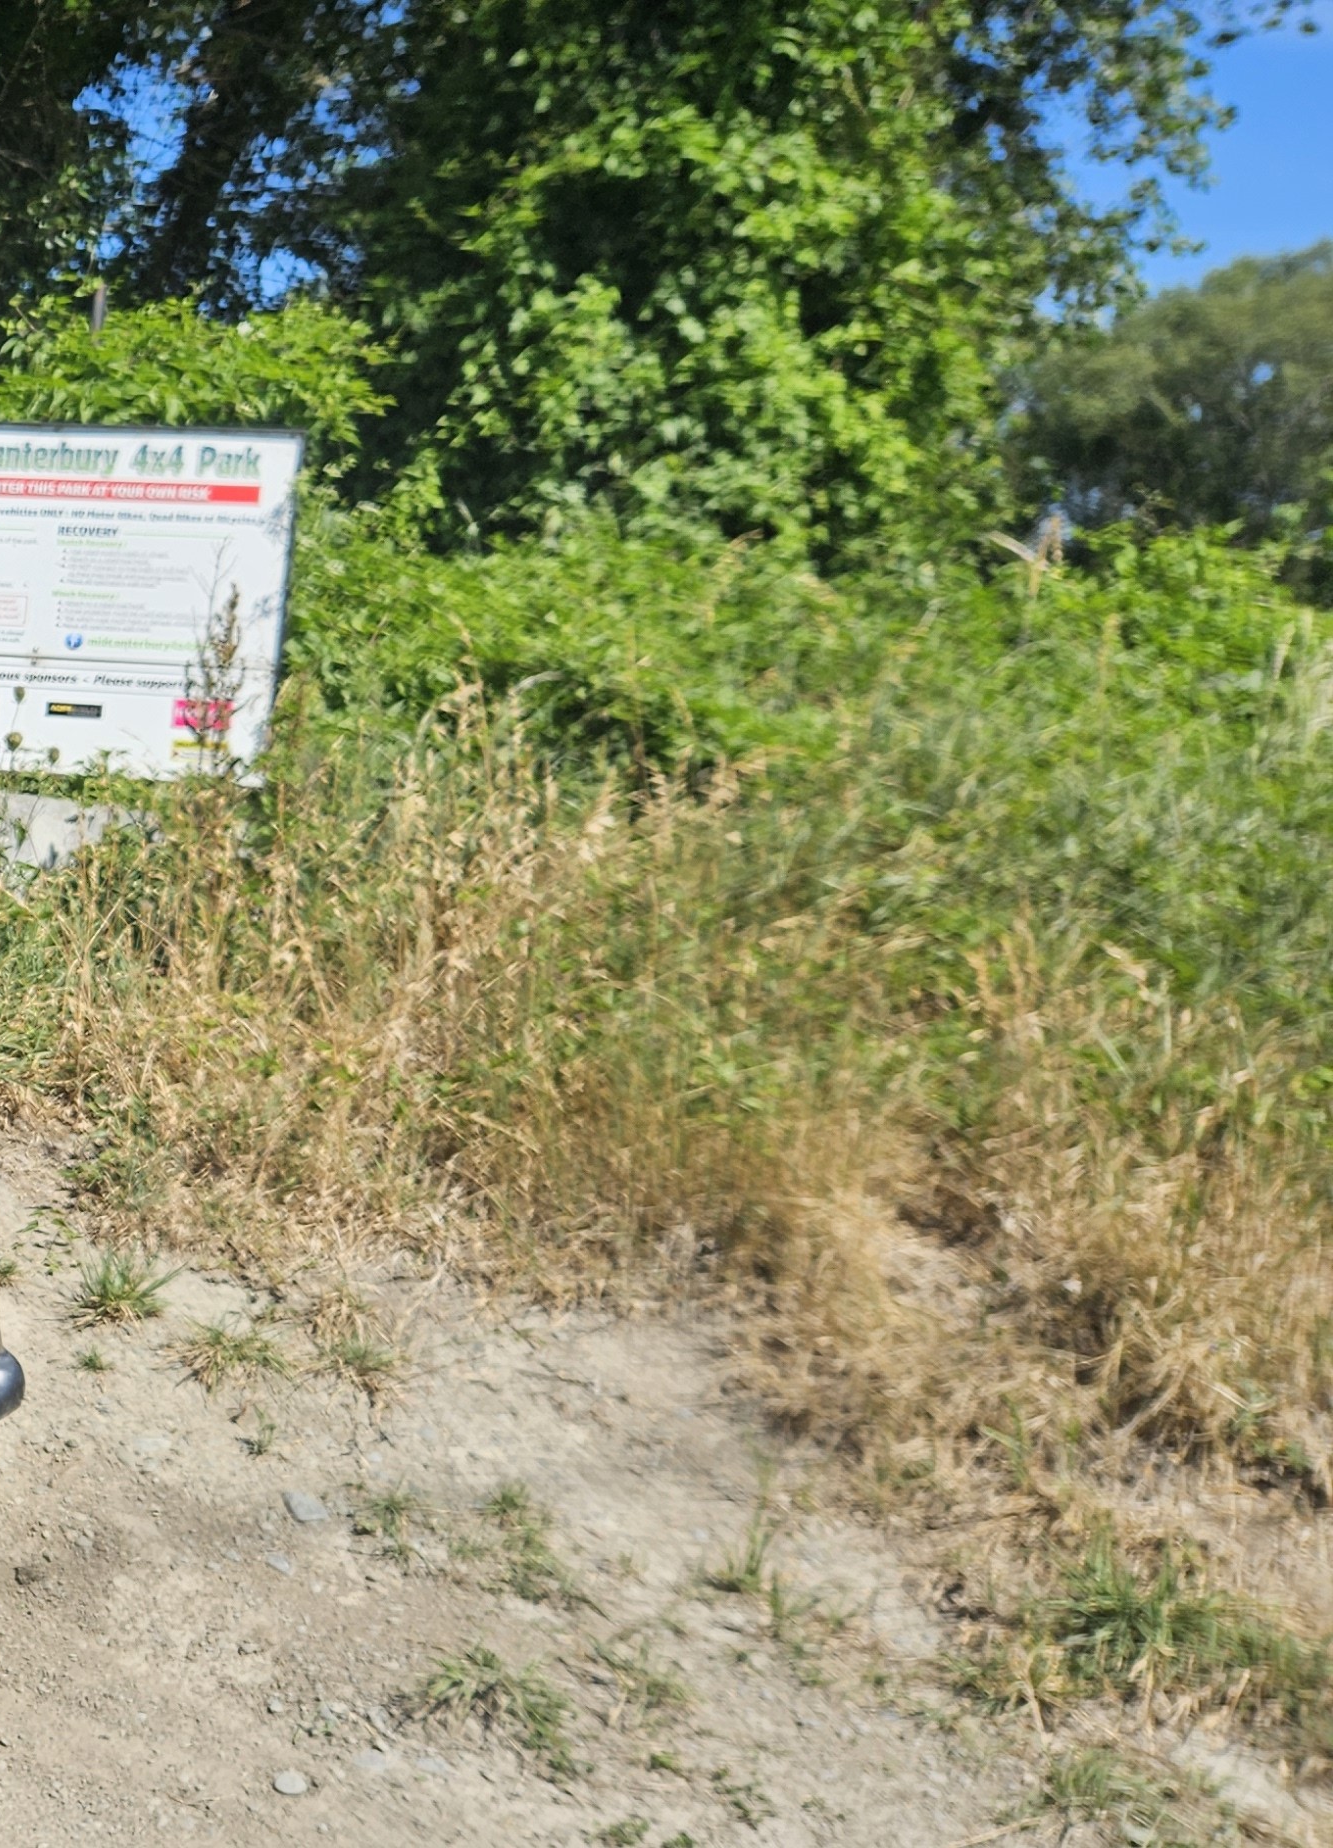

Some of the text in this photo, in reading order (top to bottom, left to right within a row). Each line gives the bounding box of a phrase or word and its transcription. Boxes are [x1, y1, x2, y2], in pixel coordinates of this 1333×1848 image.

[131, 444, 186, 476] 4x4
[197, 446, 263, 478] Park
[26, 481, 56, 496] THIS
[57, 482, 91, 497] PARK
[92, 483, 108, 498] AT
[111, 483, 145, 499] YOUR
[145, 484, 176, 500] OWN
[0, 507, 38, 517] vehicles
[39, 508, 63, 517] ONLY
[57, 526, 118, 538] RECOVERY
[23, 673, 78, 686] sponsors
[94, 674, 134, 686] Please
